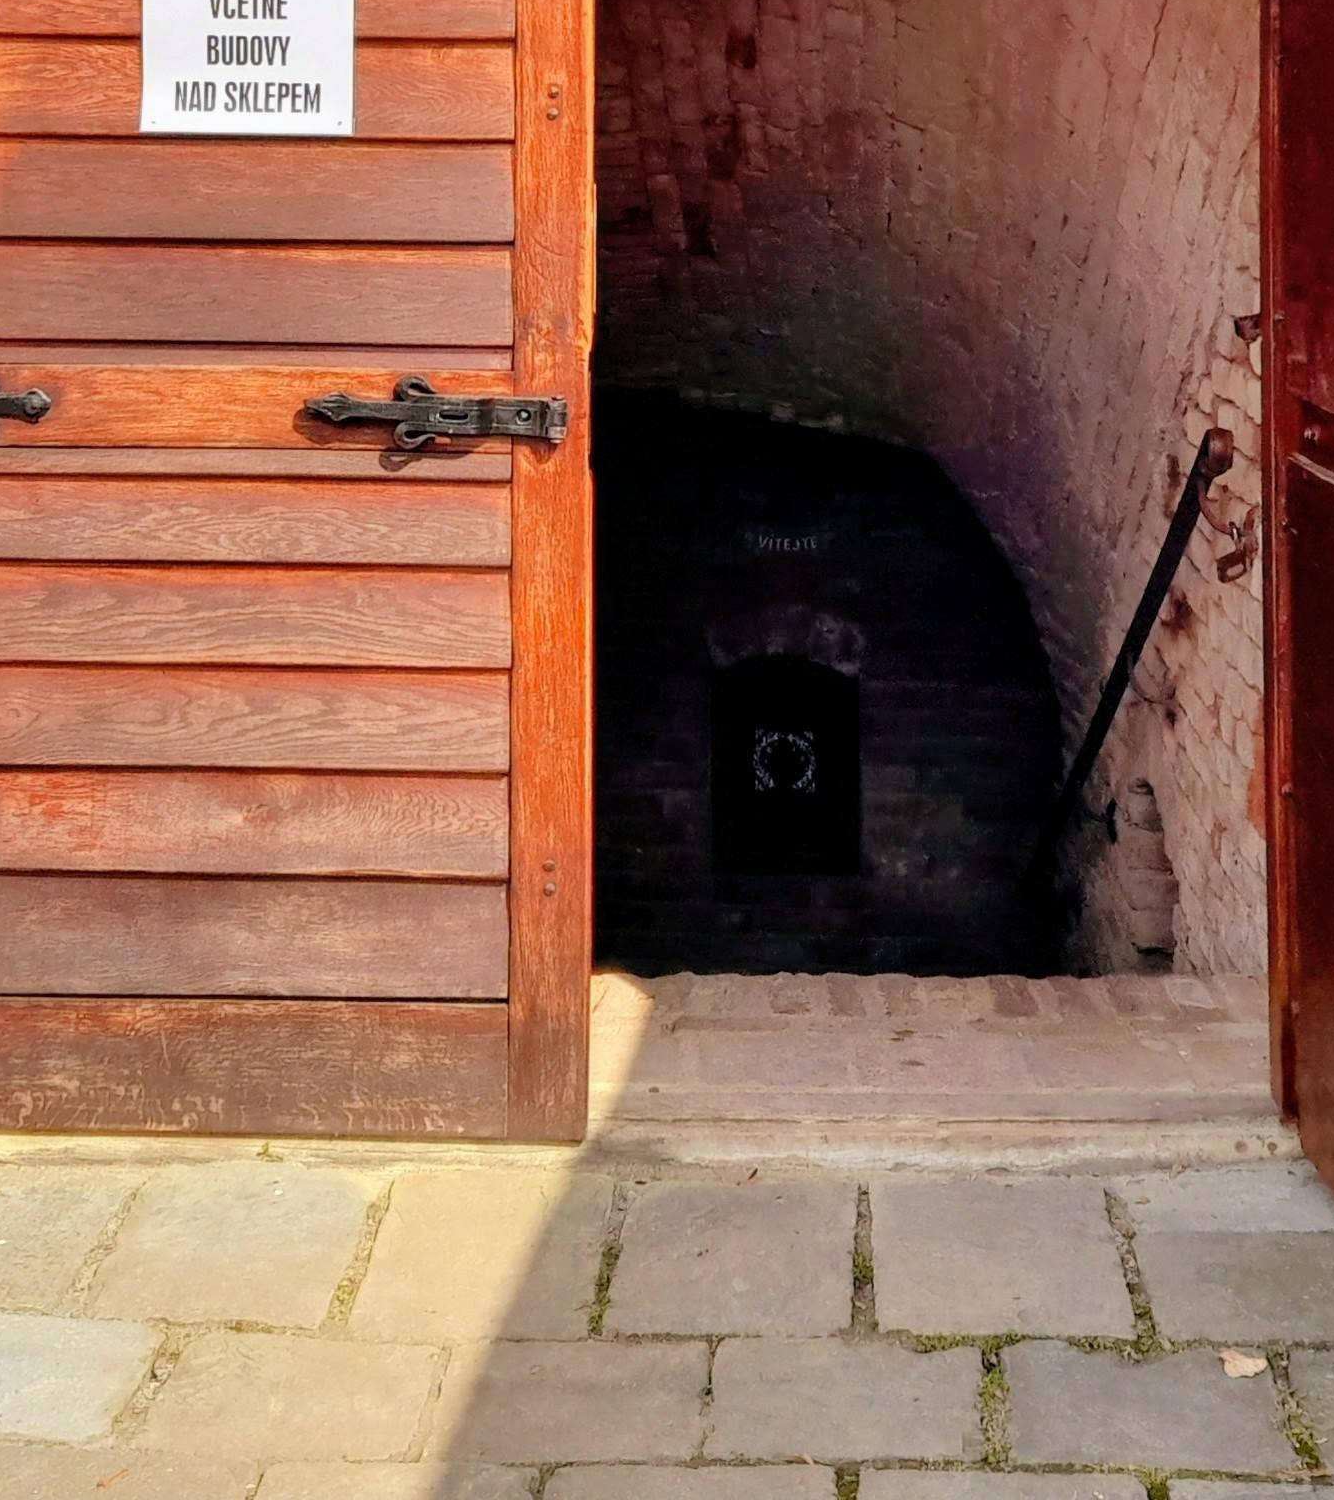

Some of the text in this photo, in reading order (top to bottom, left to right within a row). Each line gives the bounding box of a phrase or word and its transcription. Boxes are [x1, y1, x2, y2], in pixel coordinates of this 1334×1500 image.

[206, 35, 291, 66] BUDOVY
[174, 81, 321, 113] NAD SKLEPEM
